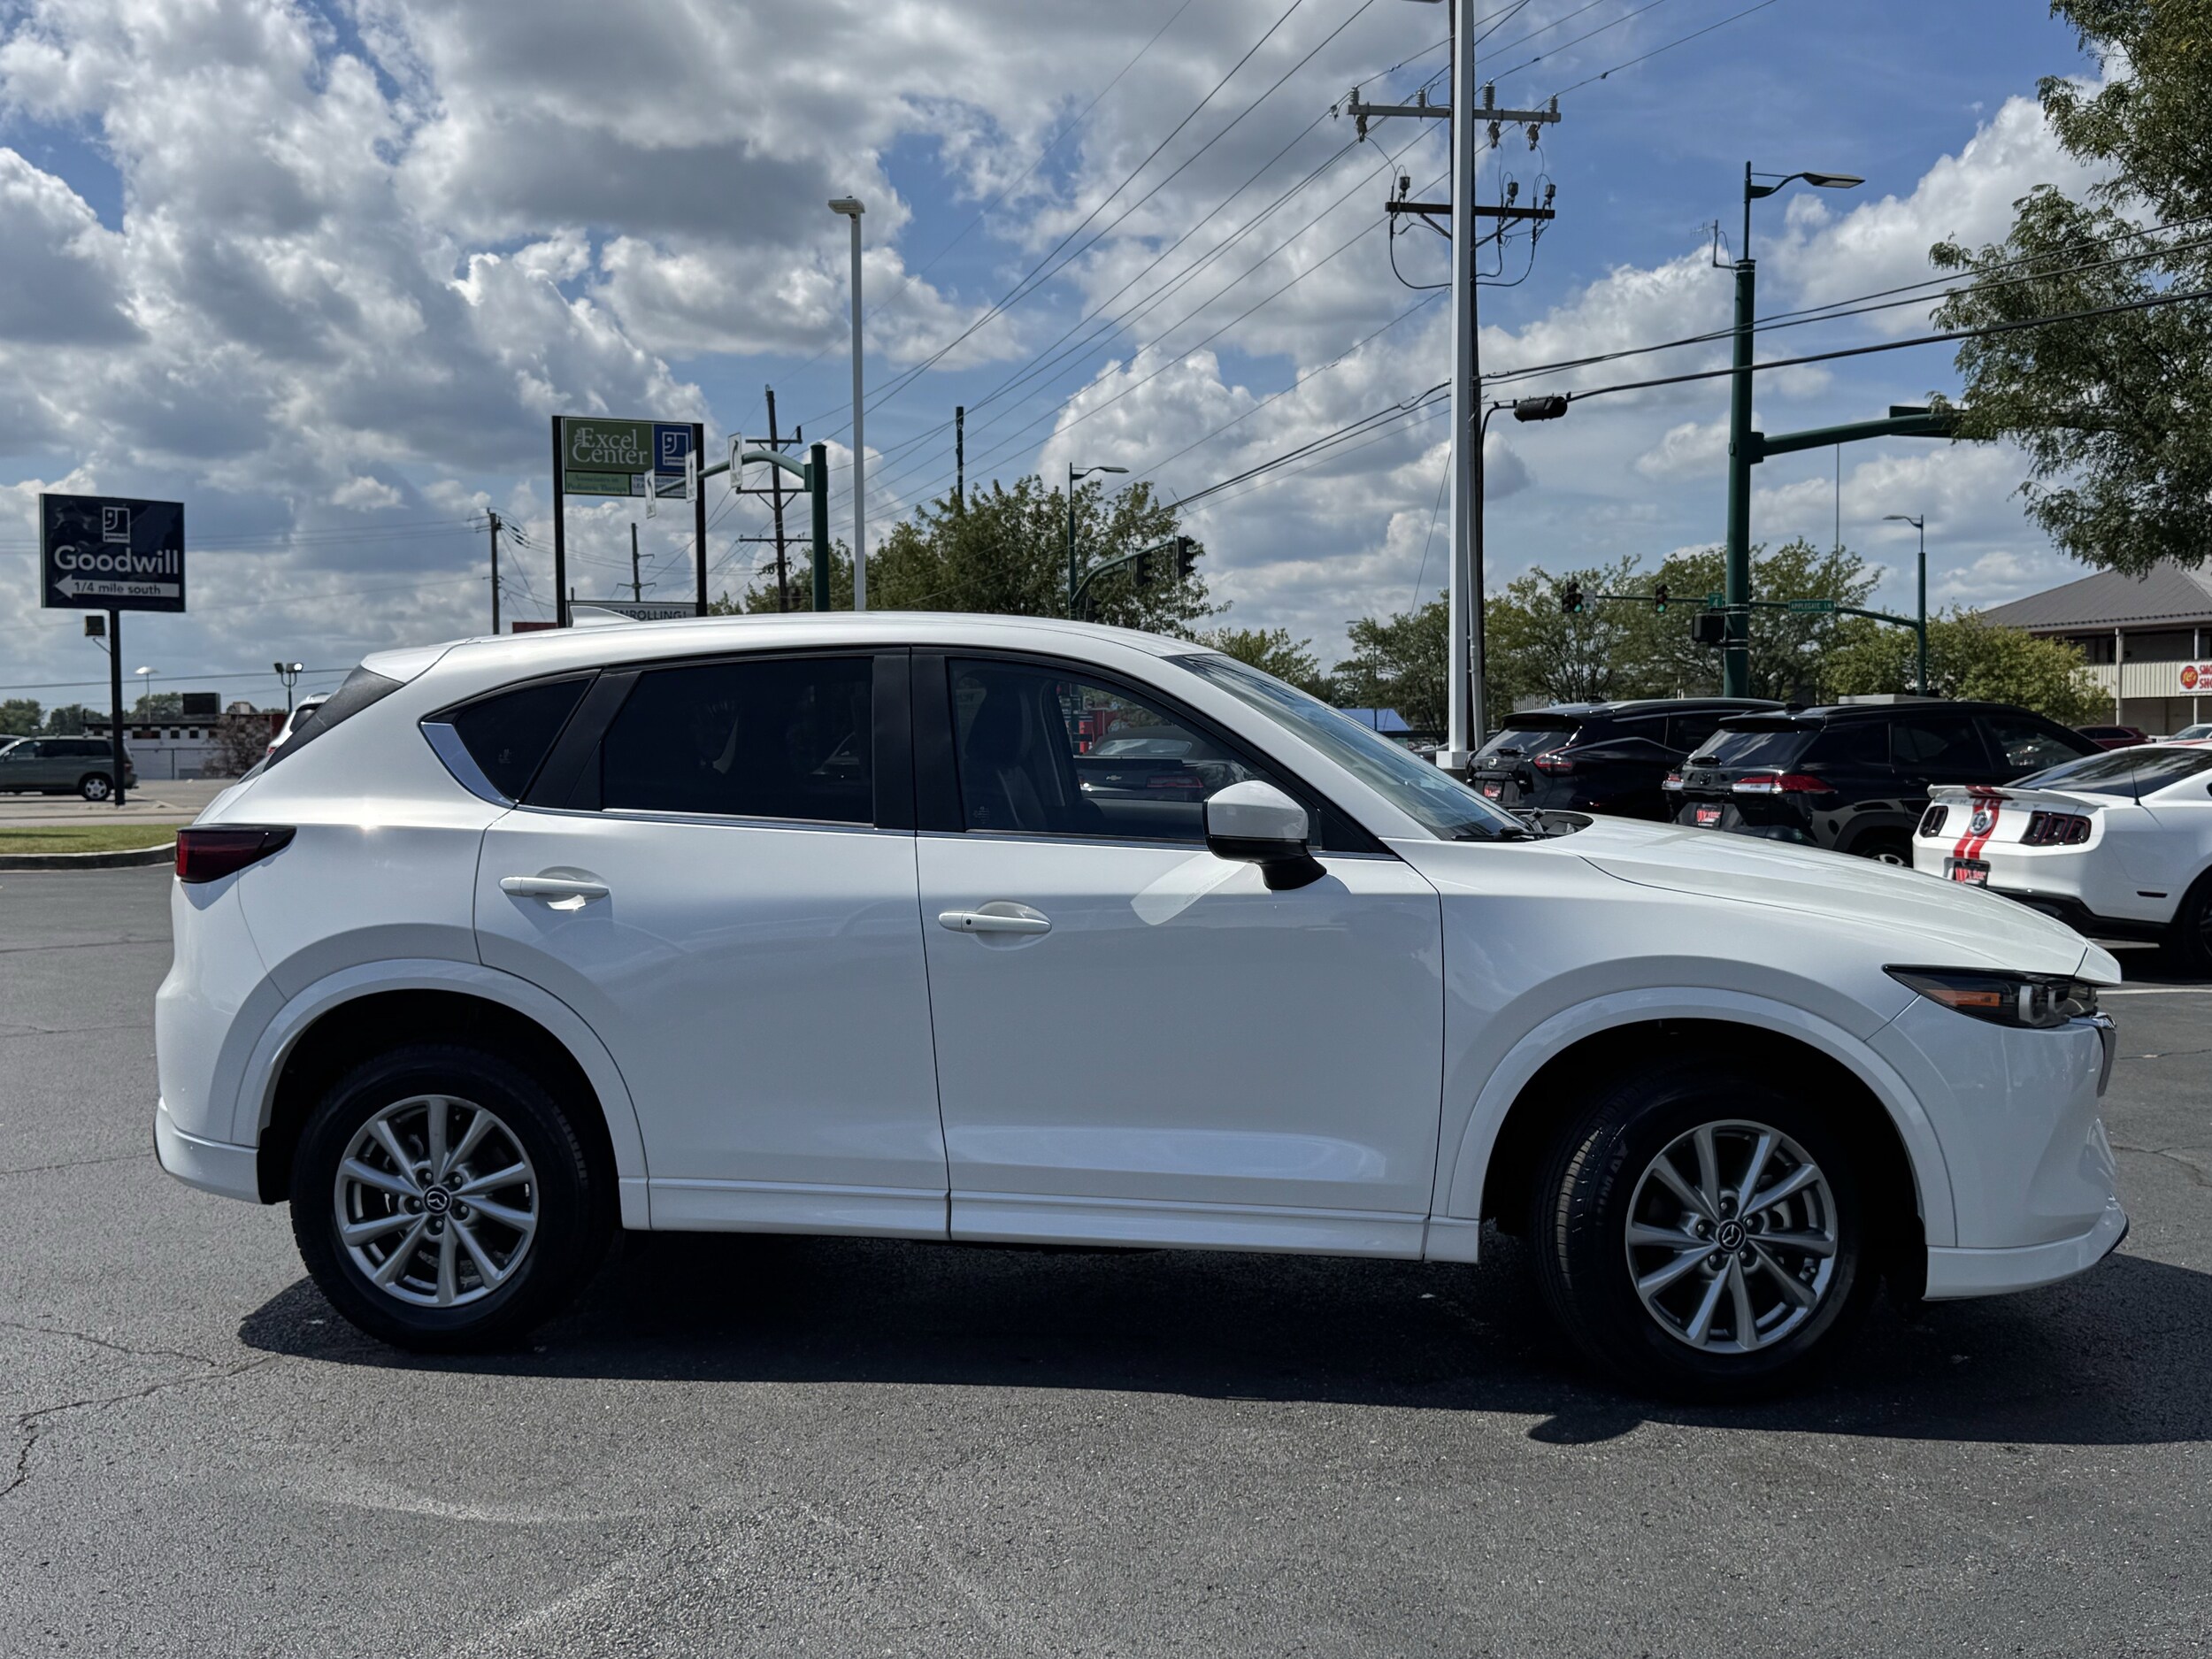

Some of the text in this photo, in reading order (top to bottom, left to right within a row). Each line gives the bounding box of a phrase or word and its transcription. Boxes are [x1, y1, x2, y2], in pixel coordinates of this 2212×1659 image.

[580, 427, 638, 449] Excel
[572, 442, 648, 465] Center
[54, 545, 179, 574] Goodwill
[73, 582, 161, 595] 1/4 mile south
